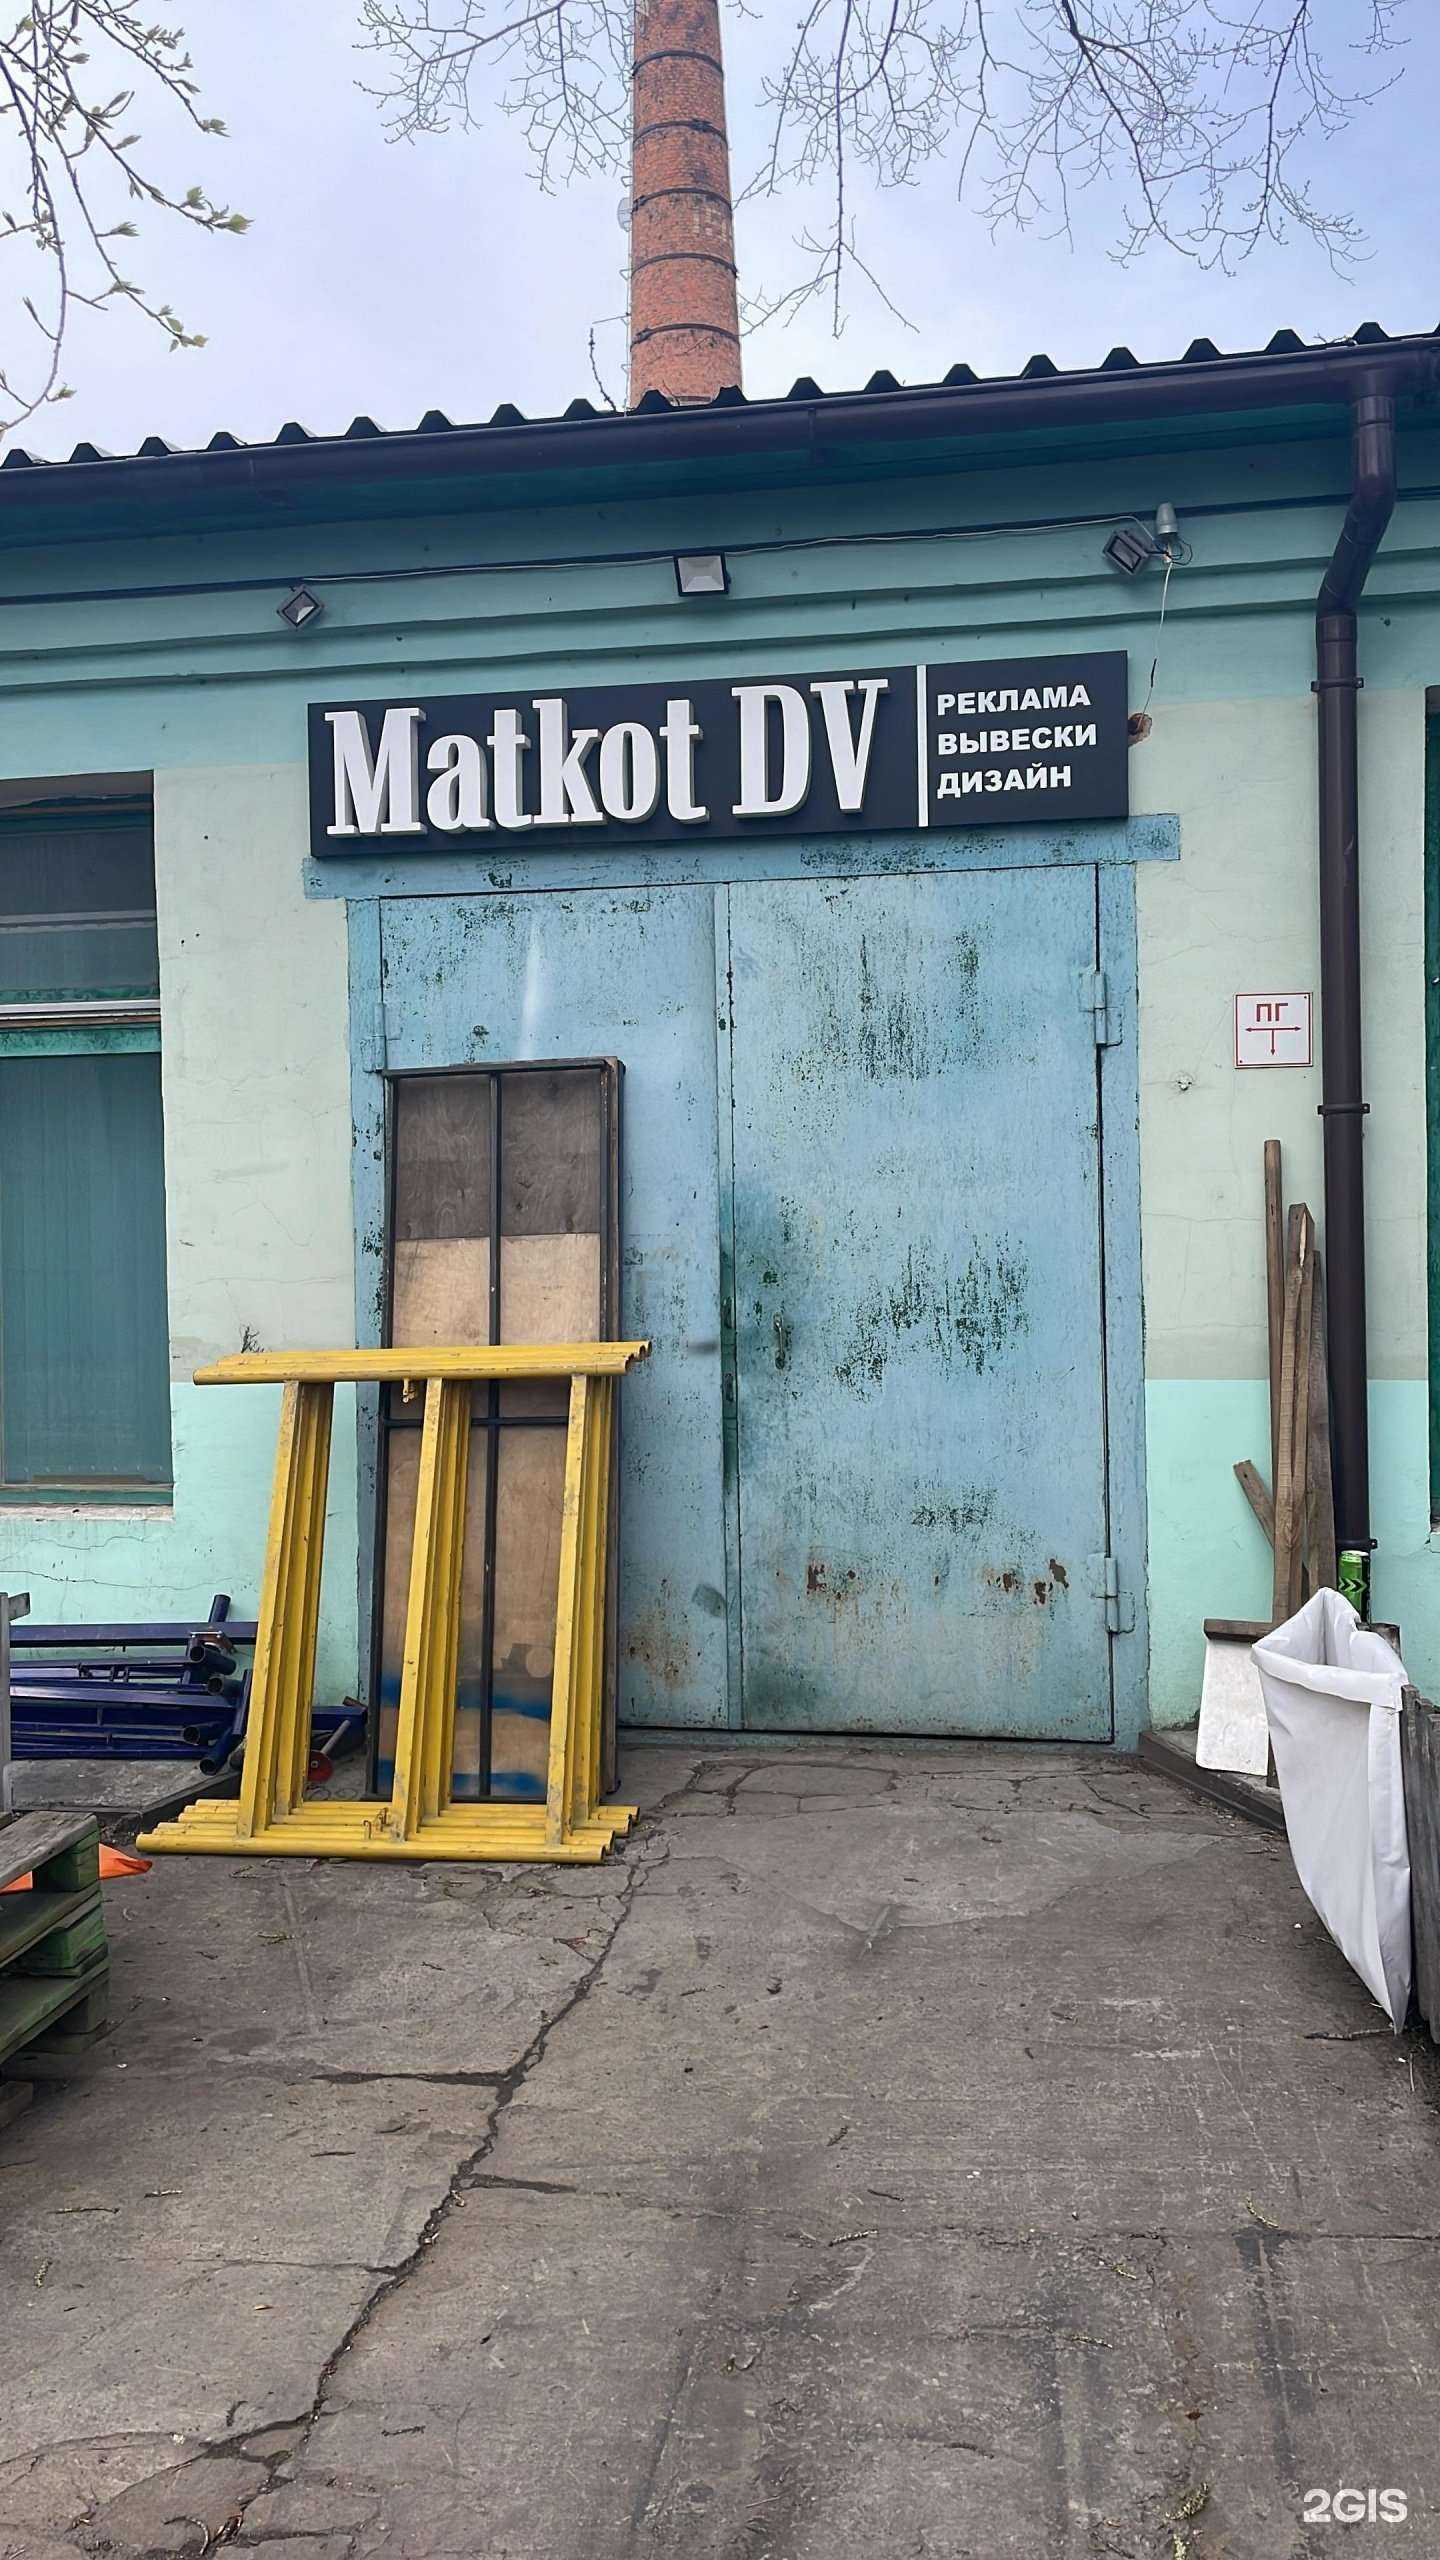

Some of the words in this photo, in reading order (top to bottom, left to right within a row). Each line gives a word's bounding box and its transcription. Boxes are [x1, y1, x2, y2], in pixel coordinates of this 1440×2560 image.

[937, 684, 1092, 716] РЕКЛАМА
[938, 723, 1098, 756] ВЫВЕСКИ
[324, 698, 710, 836] Matkot
[731, 678, 890, 818] DV
[937, 761, 1073, 800] ДИЗАЙН
[1256, 1002, 1289, 1022] ПГ
